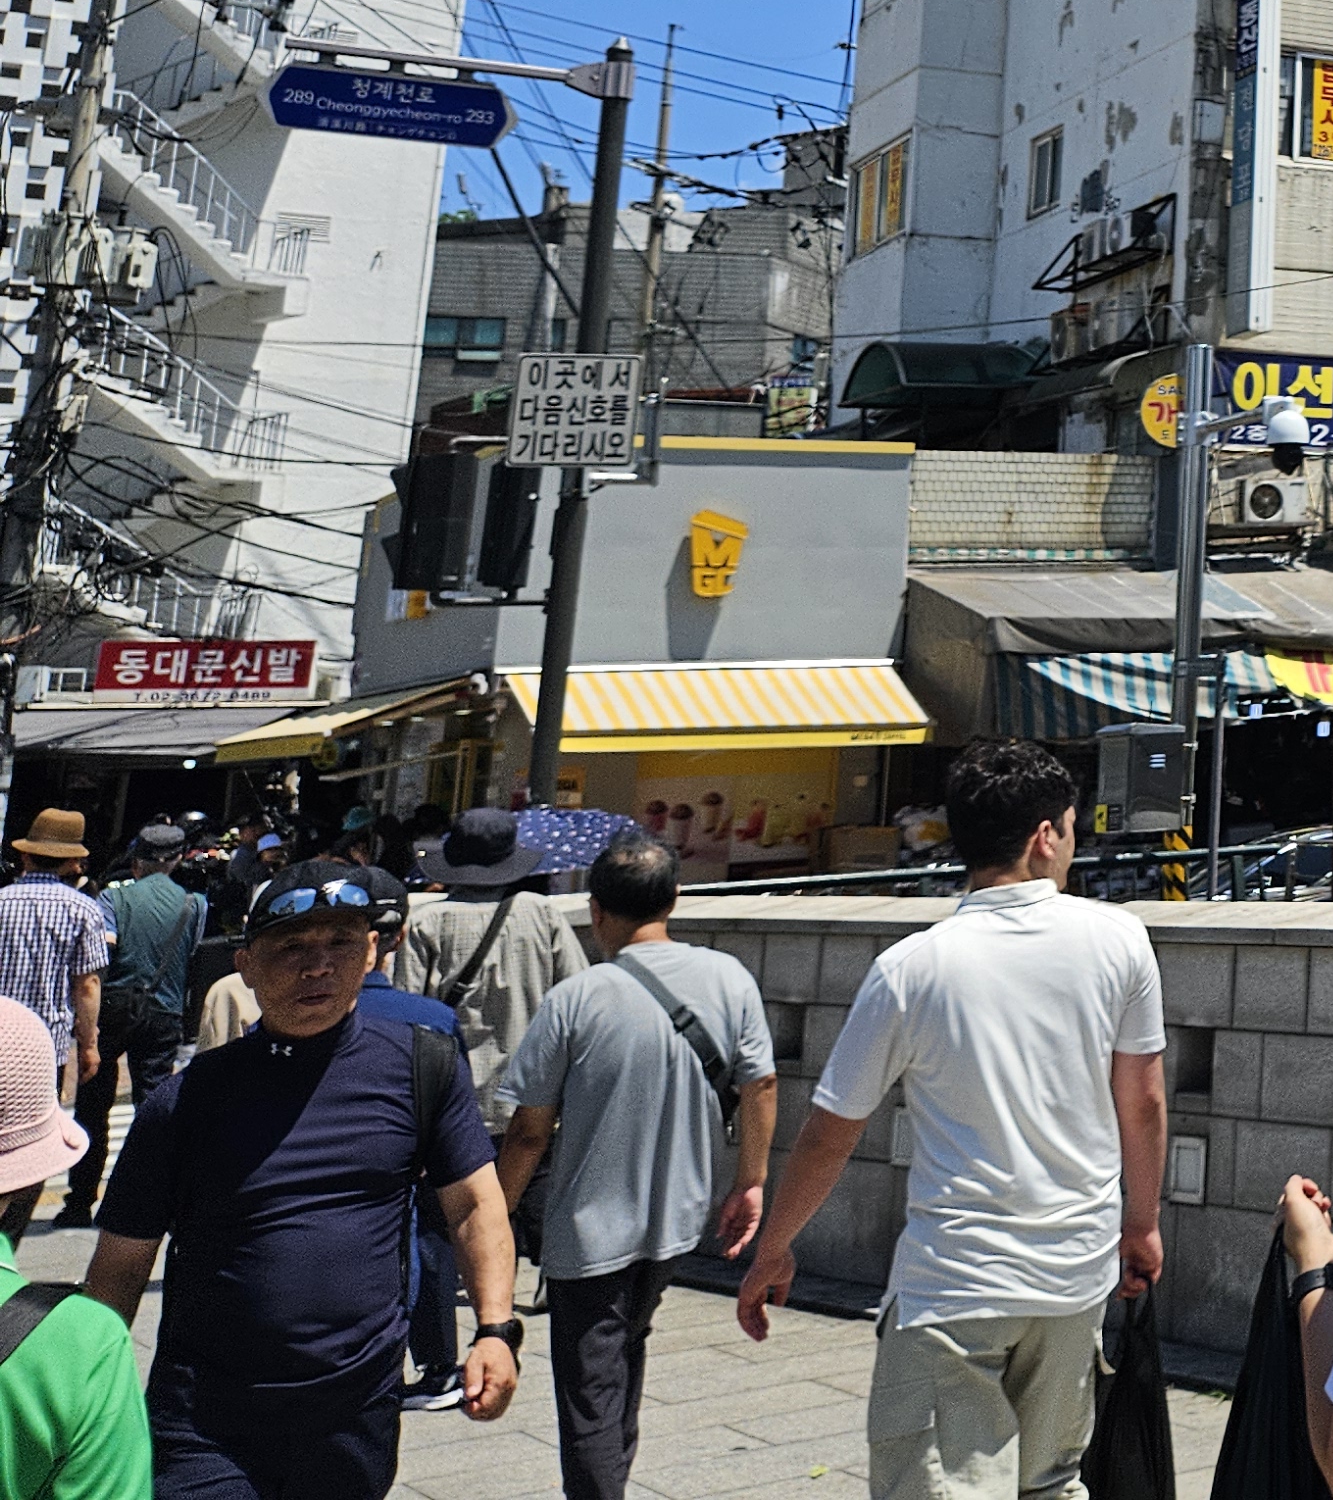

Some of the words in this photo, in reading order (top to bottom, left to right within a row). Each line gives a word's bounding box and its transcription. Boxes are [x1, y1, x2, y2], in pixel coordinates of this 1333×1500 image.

[282, 88, 314, 104] 289
[316, 97, 463, 125] Cheonggyecheon-ro
[465, 109, 495, 125] 293
[353, 78, 436, 104] 청계천로
[528, 359, 632, 391] 이곳에서
[1233, 362, 1333, 419] 이선
[516, 430, 625, 462] 기다리시오
[112, 648, 302, 685] 동대문신발
